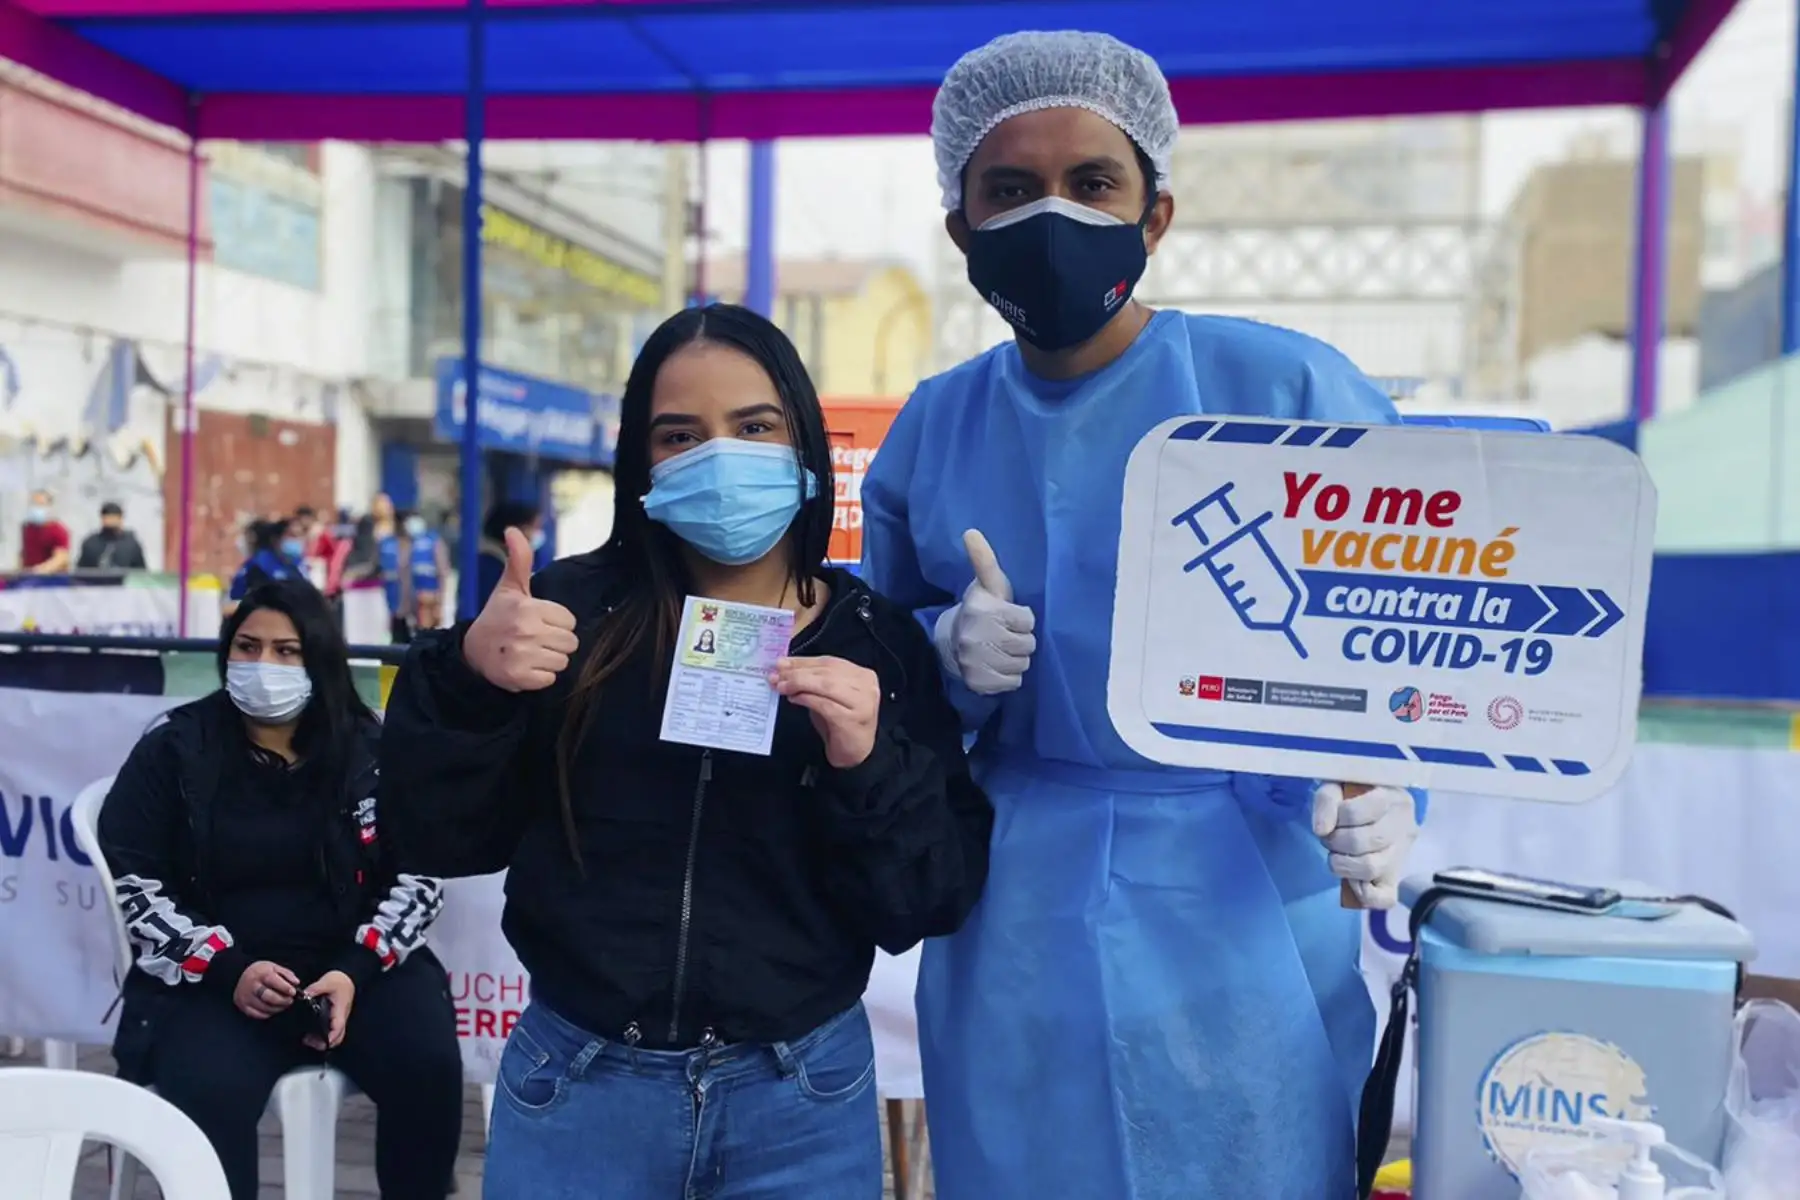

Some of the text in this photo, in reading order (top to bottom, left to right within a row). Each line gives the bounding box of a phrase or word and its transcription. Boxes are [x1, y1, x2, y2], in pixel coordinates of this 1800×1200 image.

[990, 290, 1026, 322] DIRIS
[1283, 471, 1462, 528] Yo me
[1301, 526, 1521, 577] vacuné
[1325, 584, 1512, 625] contra la
[1341, 625, 1553, 676] COVID-19
[1200, 683, 1220, 693] PERÚ
[1489, 1081, 1625, 1126] MINS
